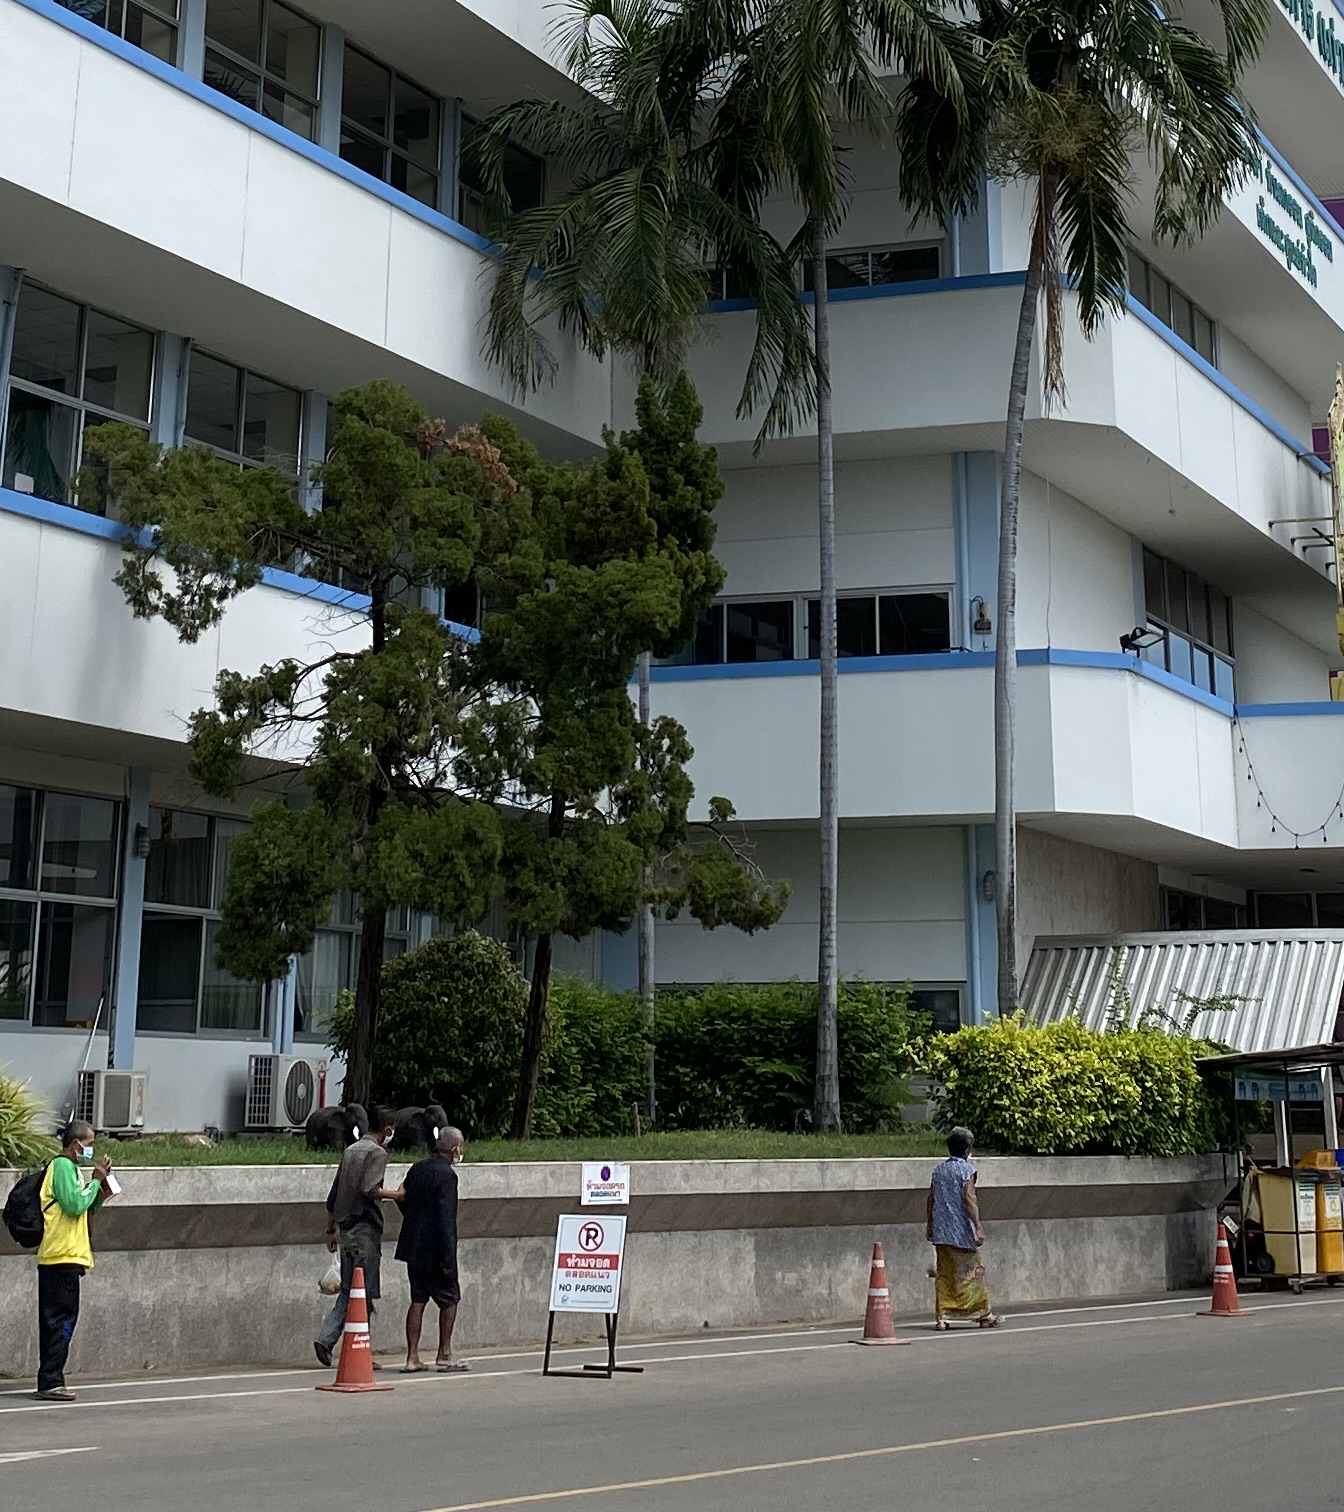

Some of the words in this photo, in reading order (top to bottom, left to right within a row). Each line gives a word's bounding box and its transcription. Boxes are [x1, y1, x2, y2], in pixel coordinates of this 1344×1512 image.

[566, 1254, 610, 1268] ห้ามจอด
[565, 1270, 610, 1280] ตลอดแนว
[558, 1283, 572, 1292] NO
[575, 1284, 612, 1294] PARKING
